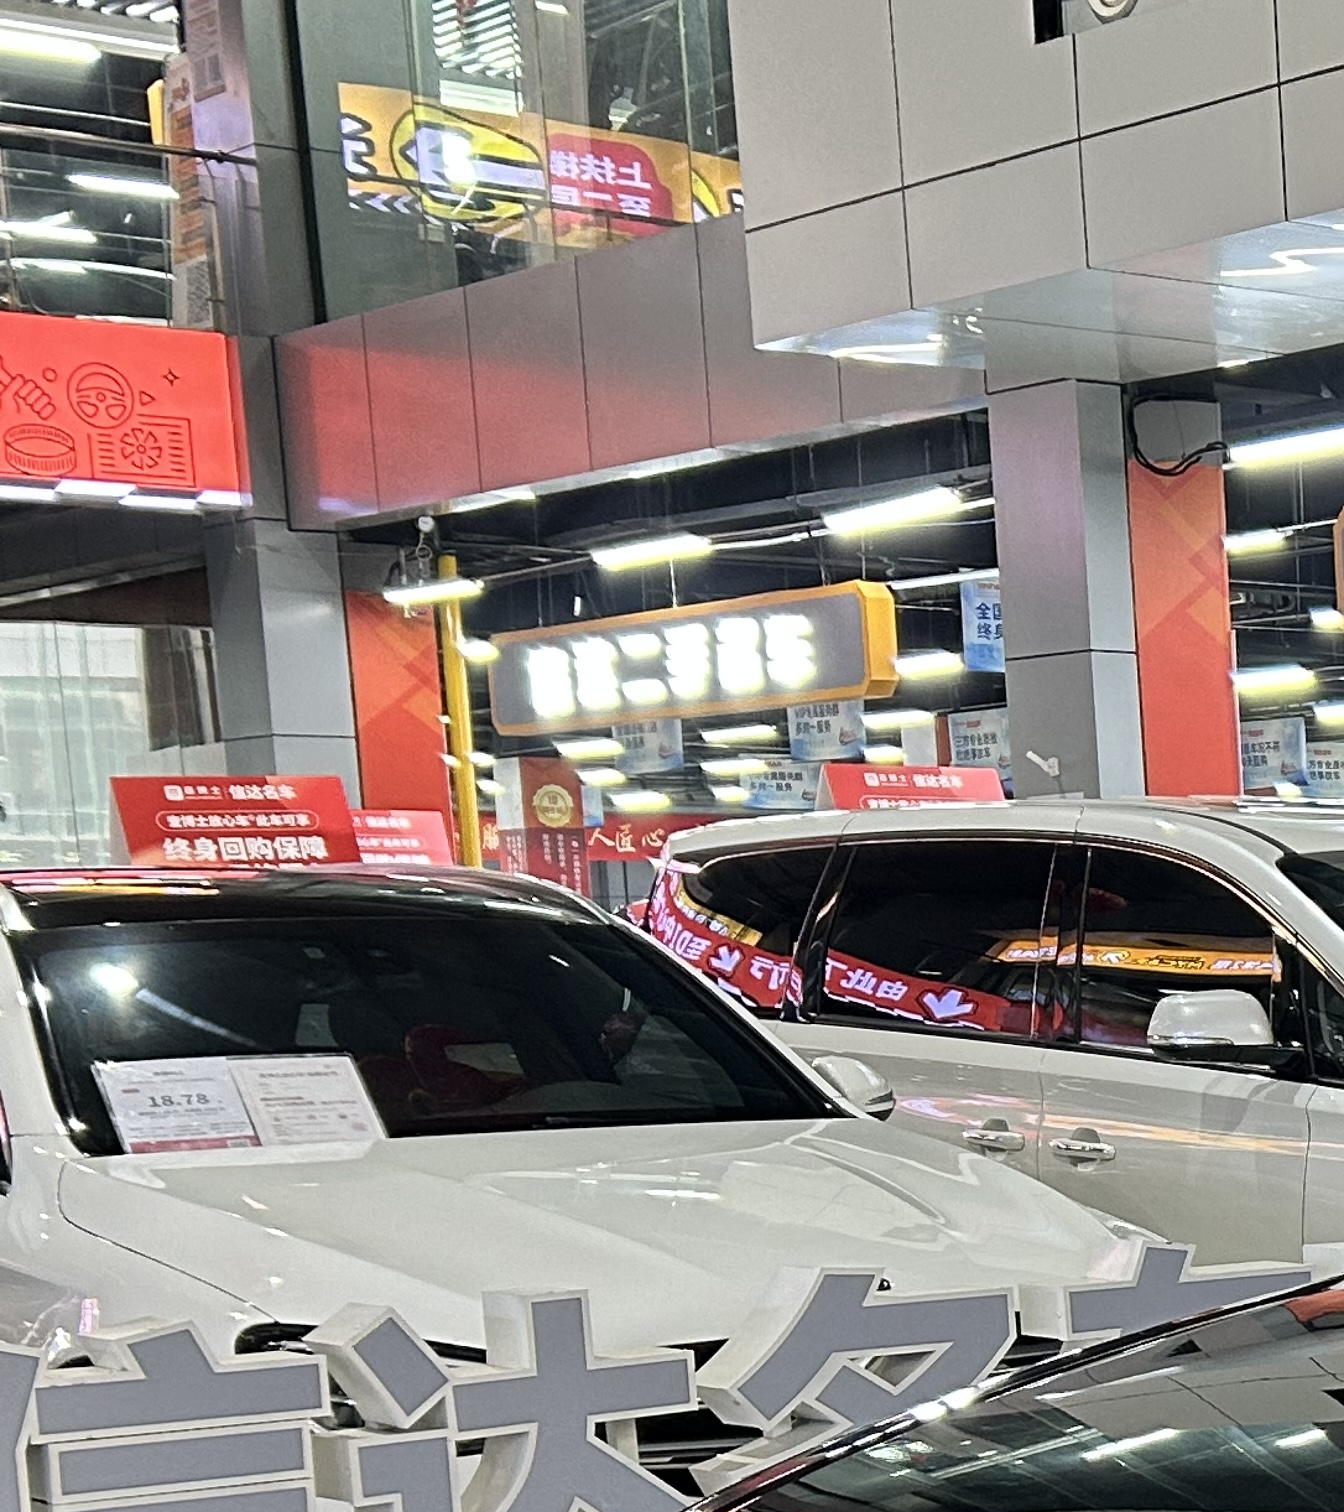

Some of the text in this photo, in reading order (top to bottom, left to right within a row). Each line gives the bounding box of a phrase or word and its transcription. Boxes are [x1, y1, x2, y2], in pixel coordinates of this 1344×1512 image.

[162, 836, 328, 861] 终身回购保障
[147, 1093, 210, 1108] 18.78
